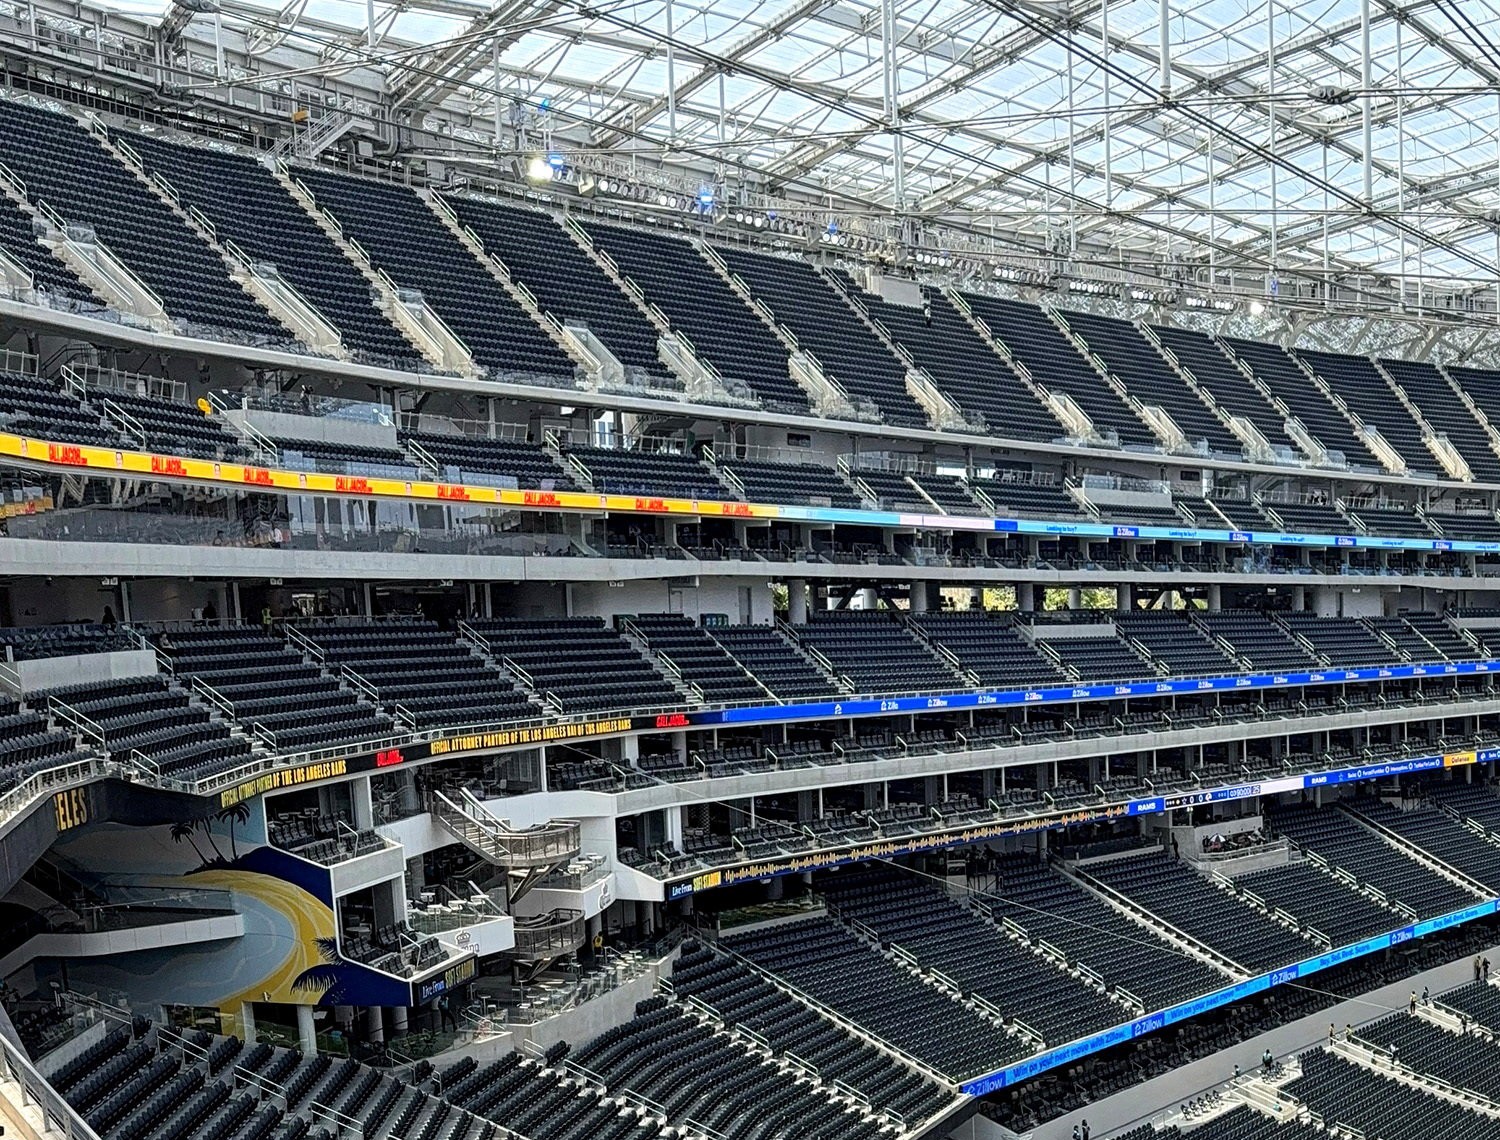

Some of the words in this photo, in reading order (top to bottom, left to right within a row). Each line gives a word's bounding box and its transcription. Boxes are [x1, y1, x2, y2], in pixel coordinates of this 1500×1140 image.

[451, 736, 482, 751] ATTORNEY
[483, 734, 510, 748] PARTNER
[519, 731, 530, 743] THE
[1138, 802, 1156, 811] RAMS
[1277, 970, 1297, 984] Zillow
[1143, 1016, 1163, 1032] Zillow
[975, 1078, 1002, 1096] Zillow
